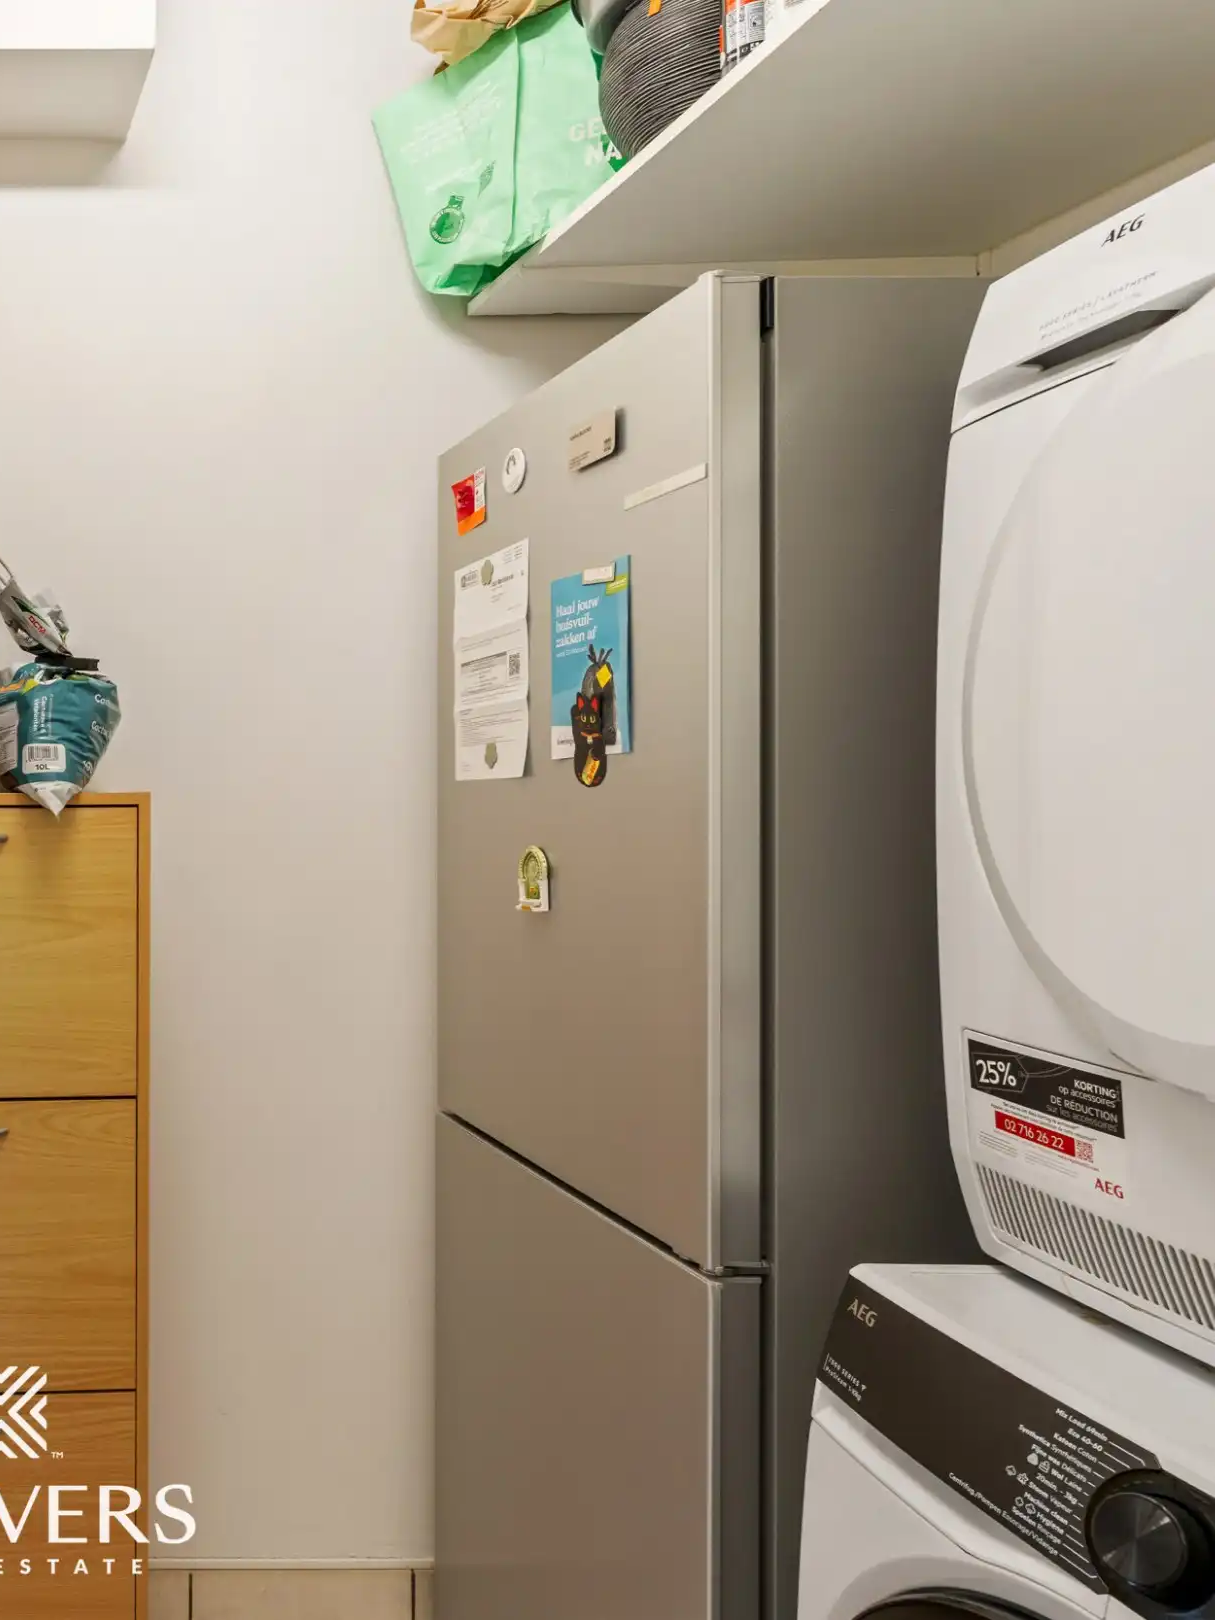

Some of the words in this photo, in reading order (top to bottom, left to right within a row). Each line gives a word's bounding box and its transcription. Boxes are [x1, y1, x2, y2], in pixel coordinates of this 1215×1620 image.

[1101, 213, 1145, 247] AEG
[556, 600, 575, 618] Haal
[577, 596, 599, 615] jouw
[35, 763, 50, 771] 10L
[975, 1059, 1017, 1087] 25%
[1058, 1086, 1069, 1096] op
[1073, 1079, 1117, 1099] KORTING
[1050, 1095, 1063, 1106] DE
[1004, 1119, 1017, 1132] 02
[1017, 1124, 1034, 1139] 716
[1036, 1130, 1049, 1144] 26
[1051, 1136, 1065, 1149] 22
[1094, 1178, 1124, 1199] AEG
[847, 1299, 878, 1327] AEG
[1055, 1408, 1068, 1418] Mix
[1053, 1432, 1077, 1450] Katoen
[1077, 1447, 1097, 1462] Coton
[1067, 1428, 1080, 1439] Eco
[1081, 1436, 1103, 1452] 40-60
[1064, 1477, 1083, 1492] Laine
[1050, 1511, 1068, 1525] clean
